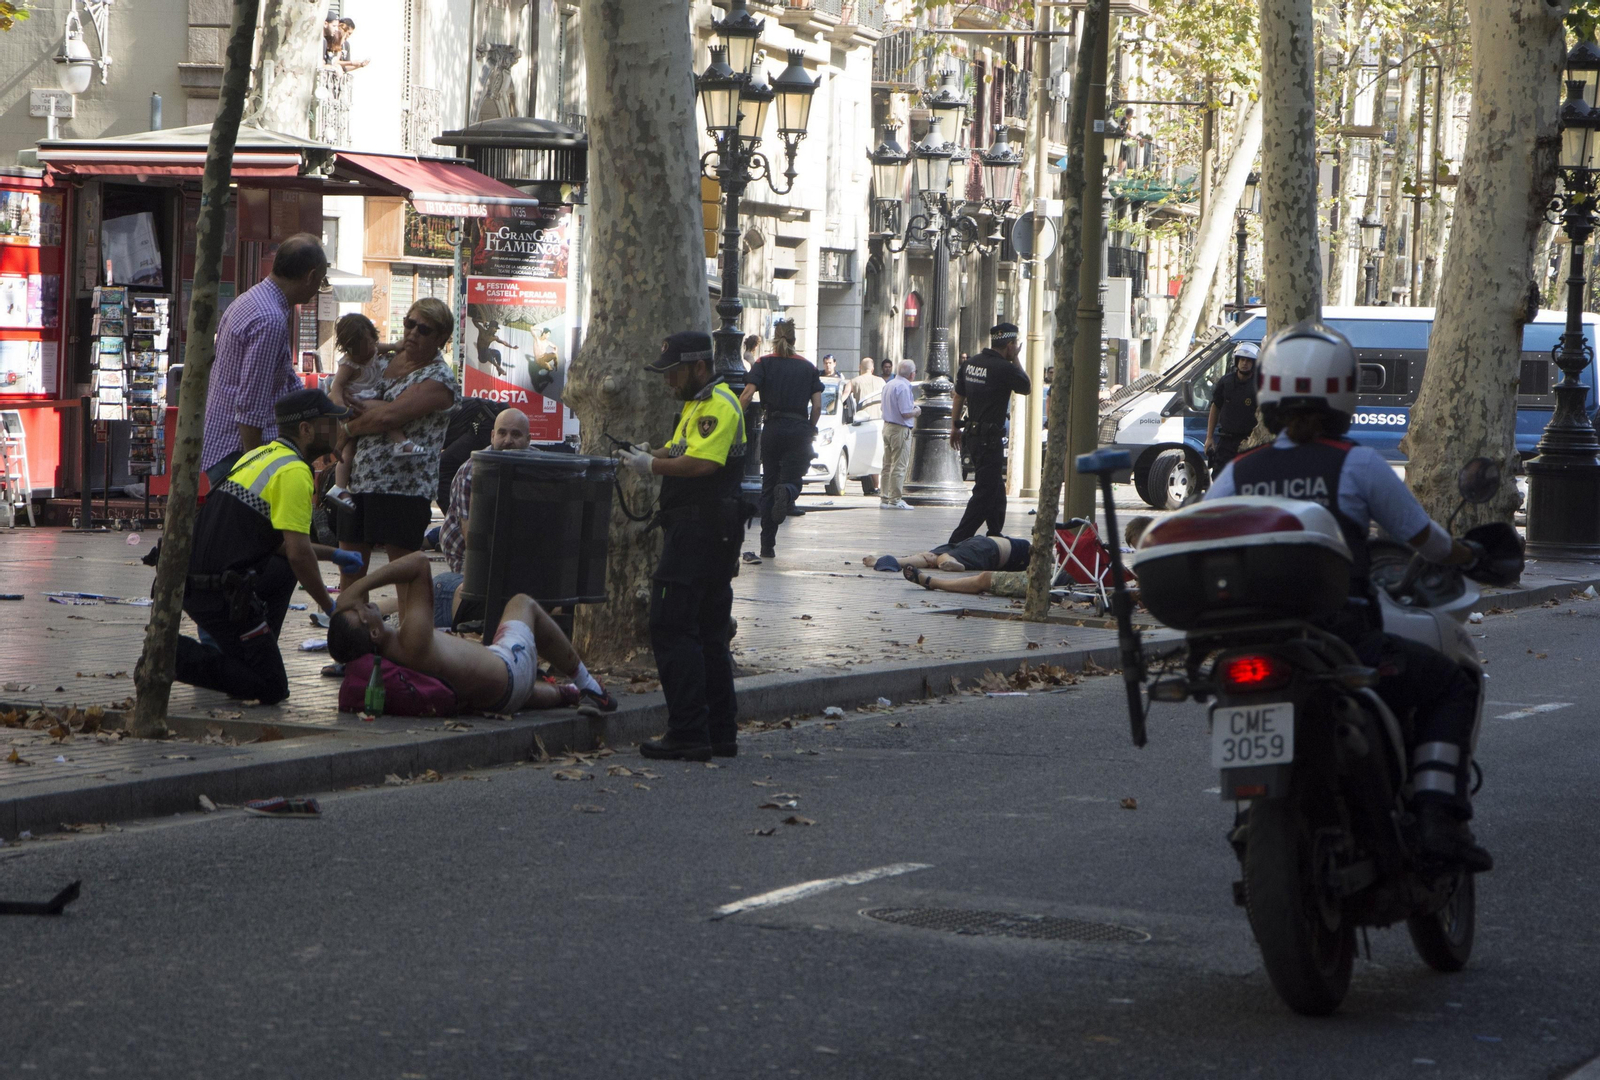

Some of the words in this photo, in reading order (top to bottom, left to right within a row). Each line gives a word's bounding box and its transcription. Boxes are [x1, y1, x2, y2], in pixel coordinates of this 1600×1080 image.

[434, 202, 460, 215] TICKETS
[468, 204, 487, 216] TRIAS
[484, 232, 561, 256] FLAMENCO
[518, 290, 557, 298] PERALADA
[966, 364, 987, 378] POLICIA
[471, 388, 528, 404] ACOSTA
[1241, 476, 1328, 497] POLICIA
[1230, 708, 1276, 735] CME
[1222, 734, 1284, 762] 3059
